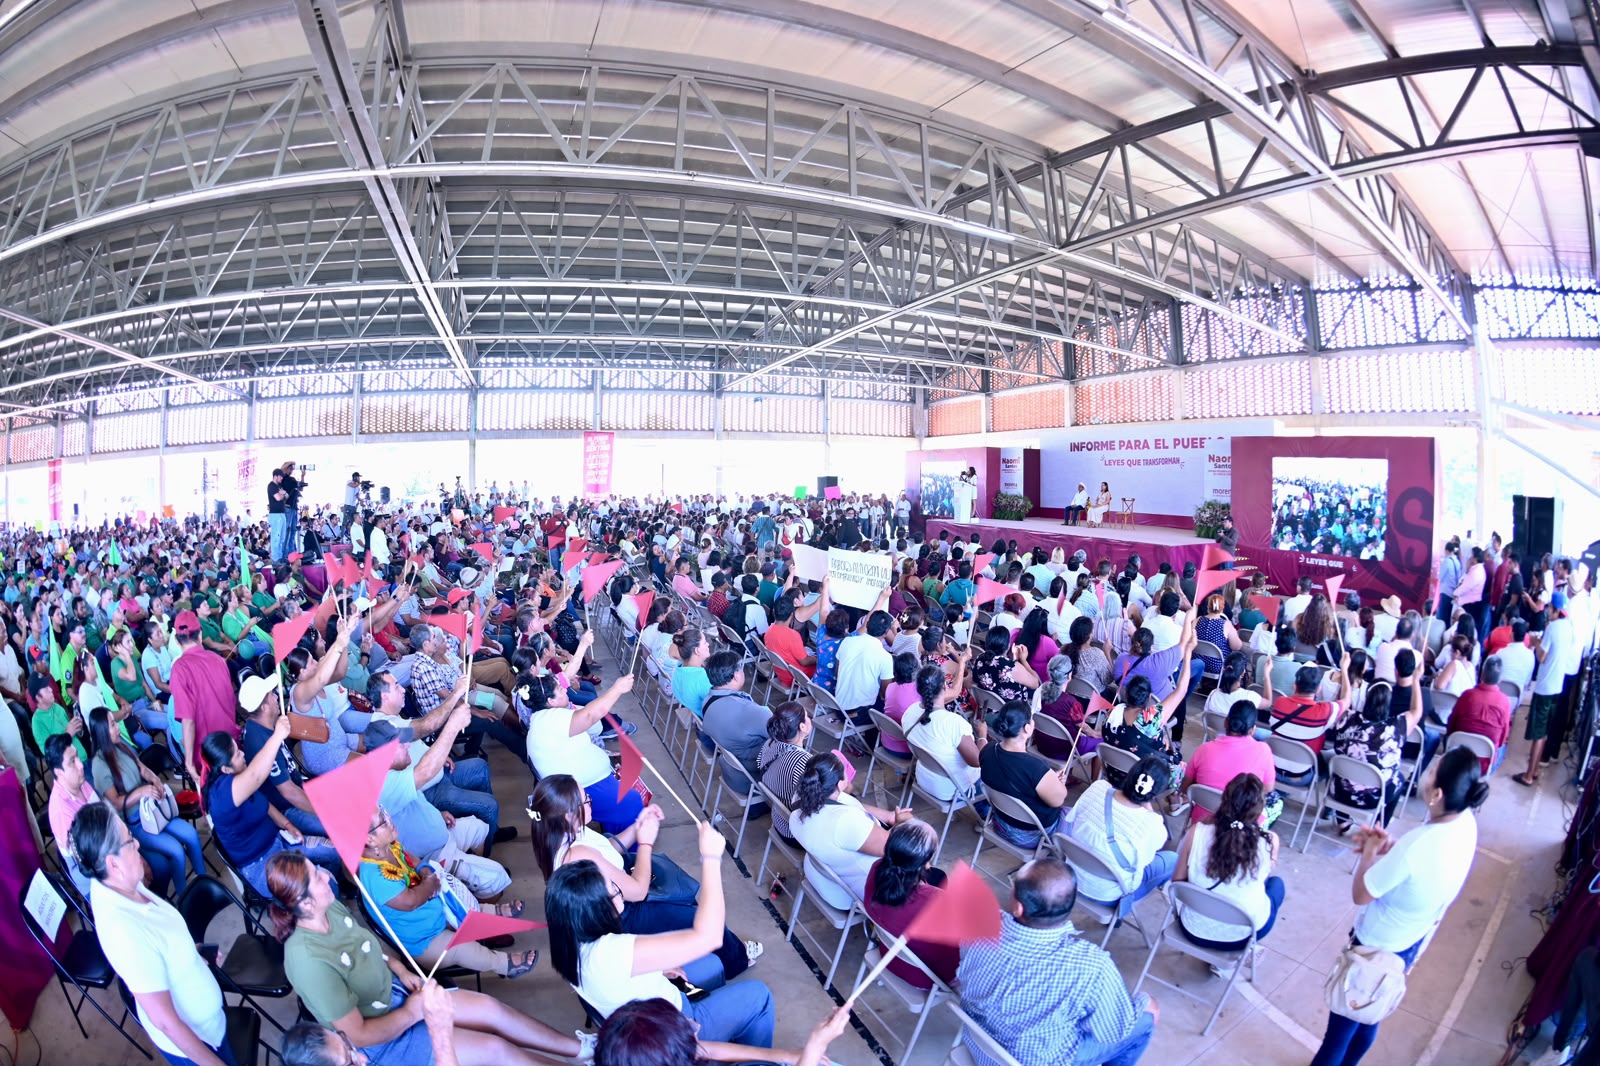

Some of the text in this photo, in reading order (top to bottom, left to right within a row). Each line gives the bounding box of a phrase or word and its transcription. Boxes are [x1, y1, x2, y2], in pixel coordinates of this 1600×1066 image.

[1070, 440, 1115, 452] INFORME
[1118, 439, 1150, 450] PARA
[1154, 438, 1169, 450] EL
[1104, 457, 1180, 467] LEYES QUE TRANSFORMAN
[1208, 454, 1231, 463] Nao
[1306, 558, 1343, 568] LEYES QUE
